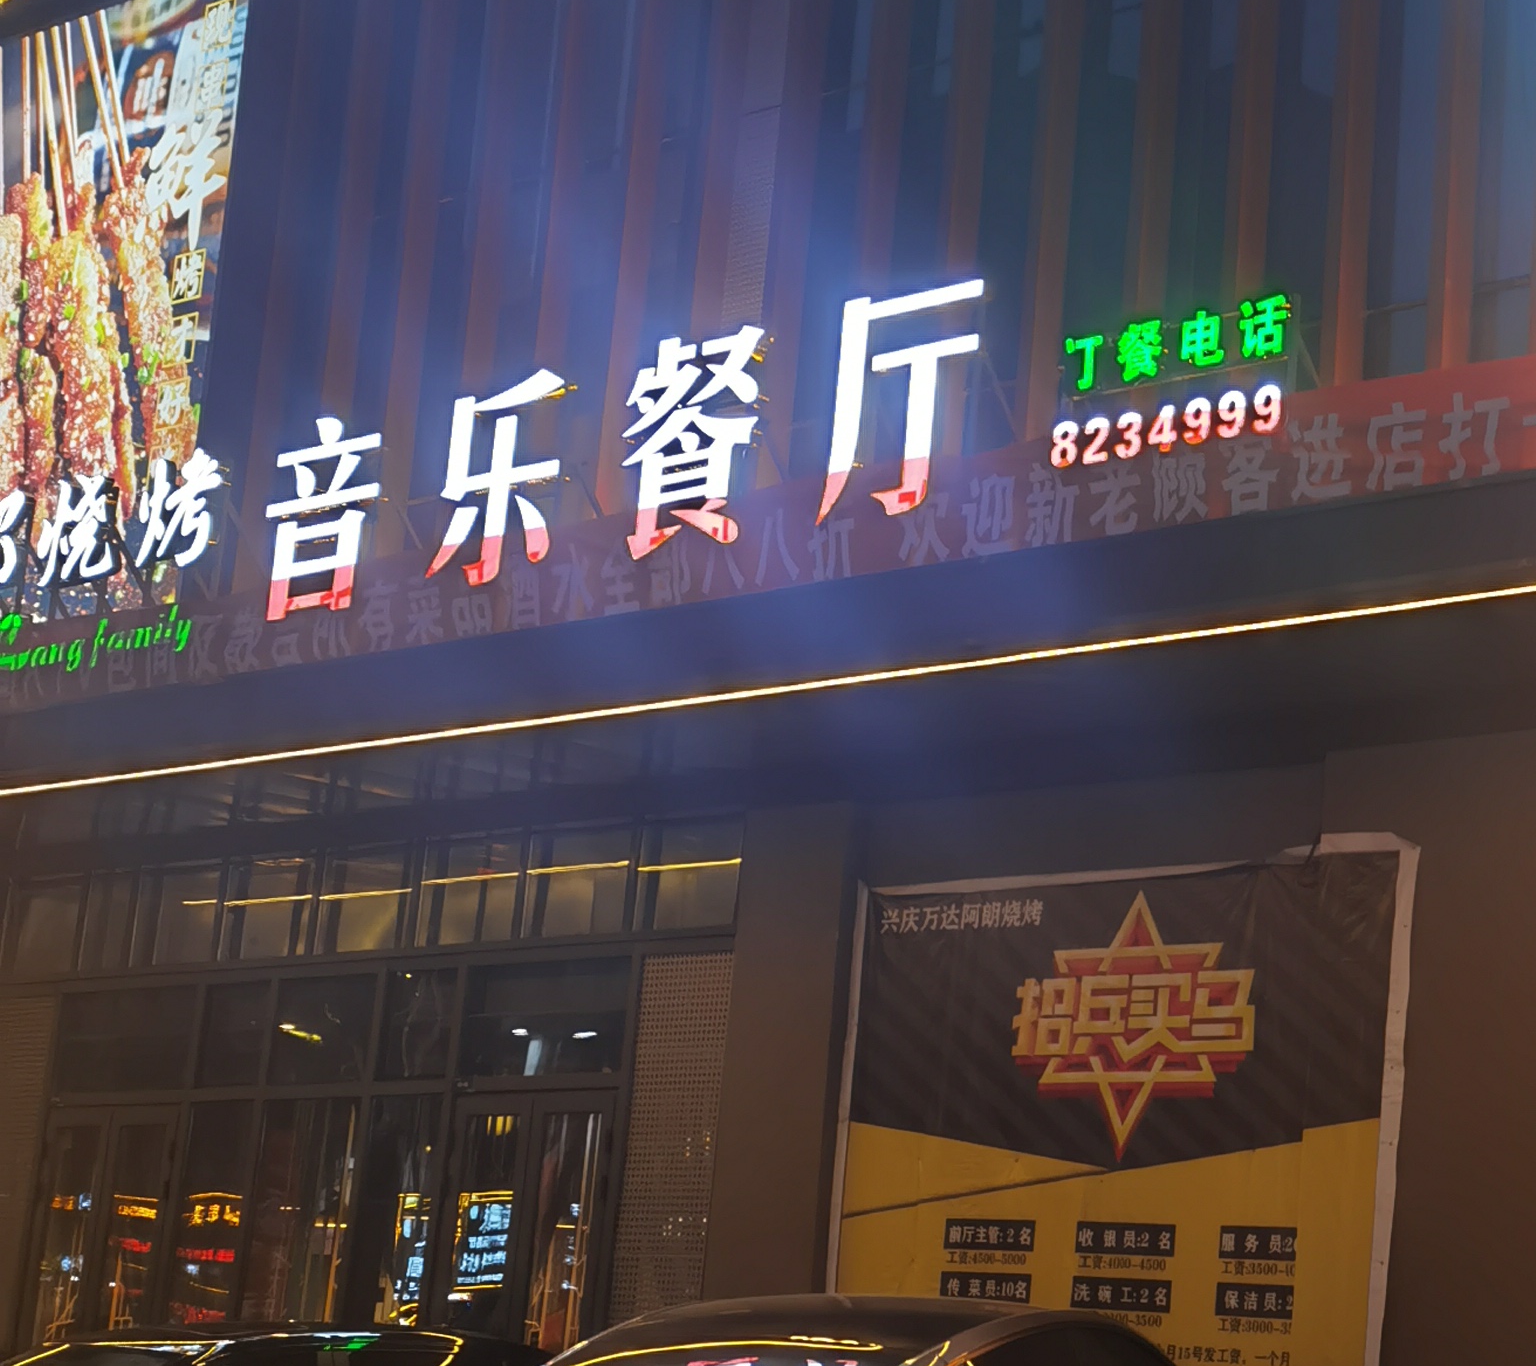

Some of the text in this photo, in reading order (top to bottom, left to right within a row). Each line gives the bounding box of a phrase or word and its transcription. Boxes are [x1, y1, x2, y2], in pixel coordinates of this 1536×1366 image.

[265, 278, 984, 621] 音乐餐厅
[1050, 384, 1283, 469] 8234999
[89, 603, 192, 670] family
[1011, 968, 1256, 1065] 招兵买马
